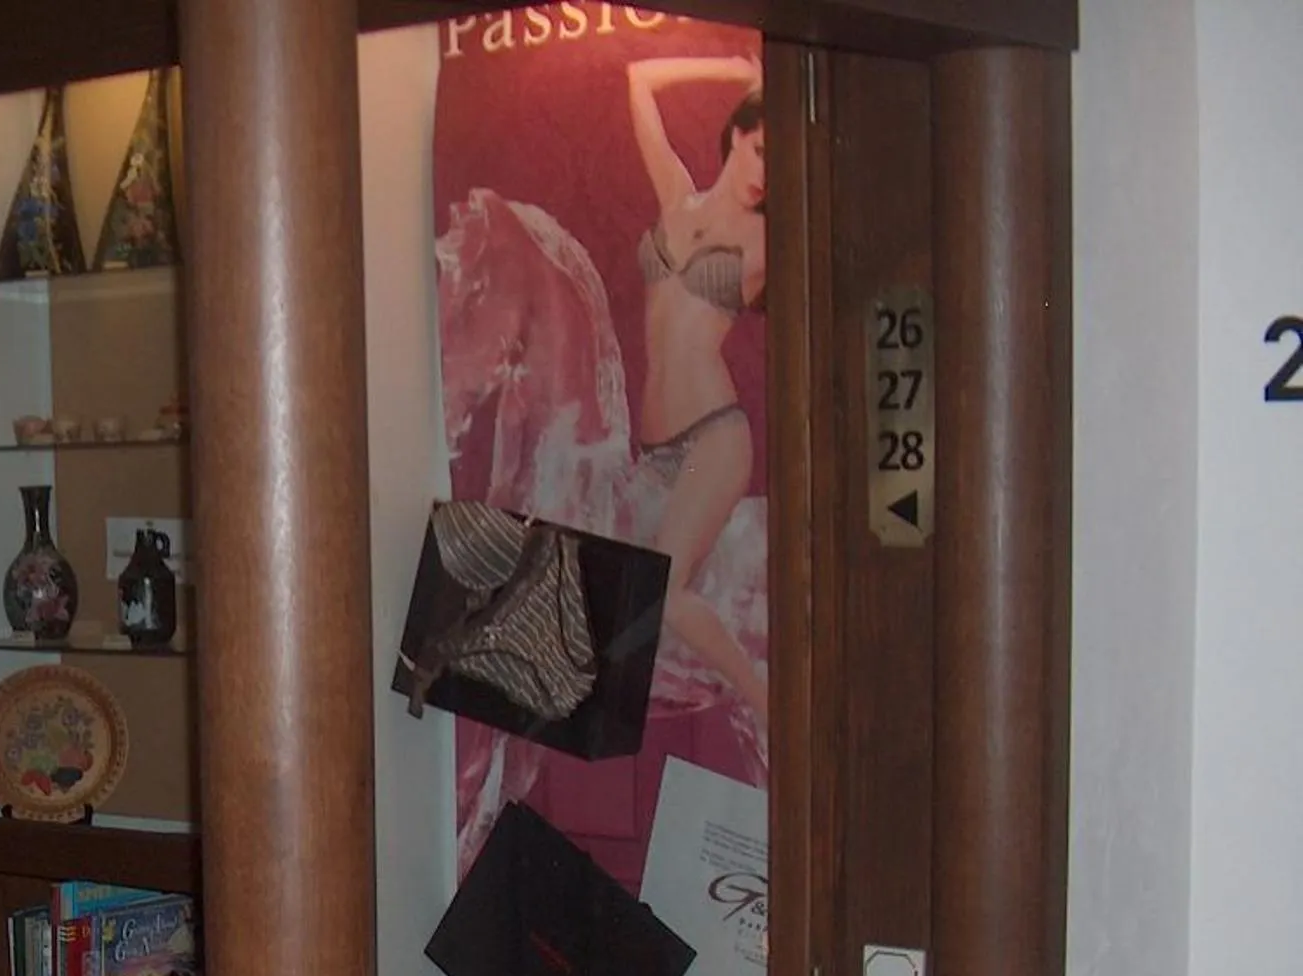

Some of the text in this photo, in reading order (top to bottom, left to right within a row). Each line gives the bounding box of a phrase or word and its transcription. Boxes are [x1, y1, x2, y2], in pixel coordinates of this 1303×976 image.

[876, 308, 923, 350] 26
[1264, 315, 1303, 402] 2
[876, 369, 923, 410] 27
[876, 430, 924, 471] 28
